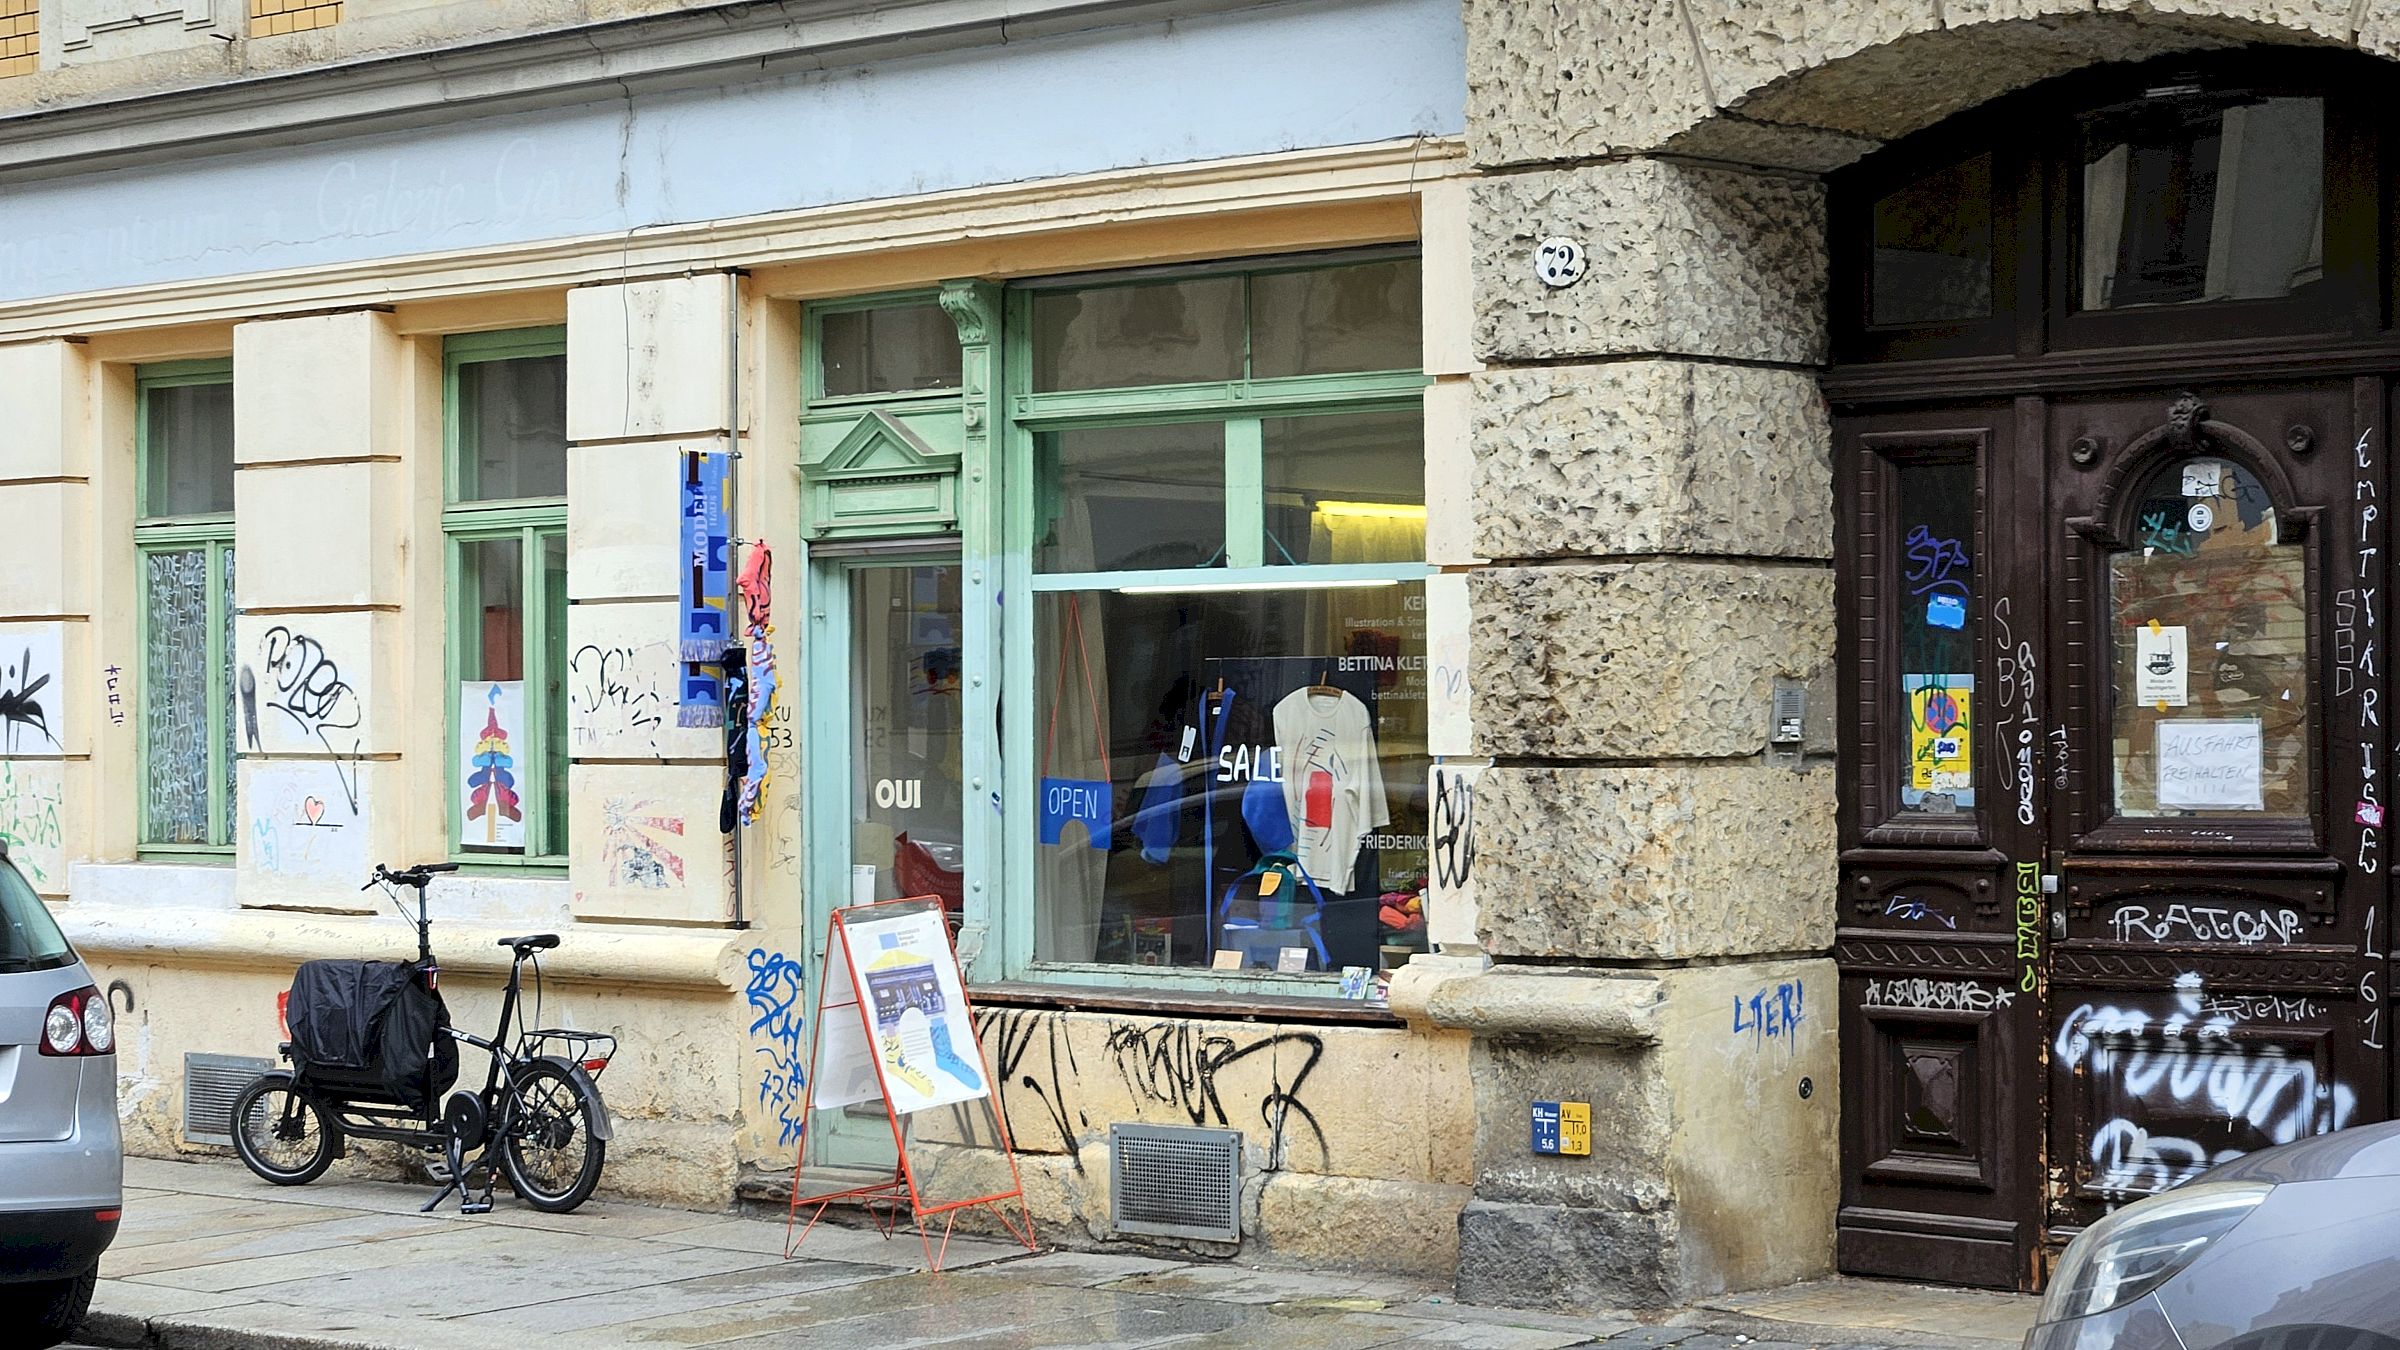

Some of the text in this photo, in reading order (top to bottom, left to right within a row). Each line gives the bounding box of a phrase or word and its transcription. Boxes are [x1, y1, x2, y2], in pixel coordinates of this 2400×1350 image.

[1397, 616, 1405, 627] &
[1338, 655, 1394, 672] BETTINA
[2163, 734, 2258, 758] AUSFAHRT
[1216, 743, 1286, 783] SALE
[2163, 763, 2253, 781] FREIHALTEN
[875, 778, 921, 809] OUI
[1048, 787, 1098, 820] OPEN
[1532, 1107, 1544, 1118] KH
